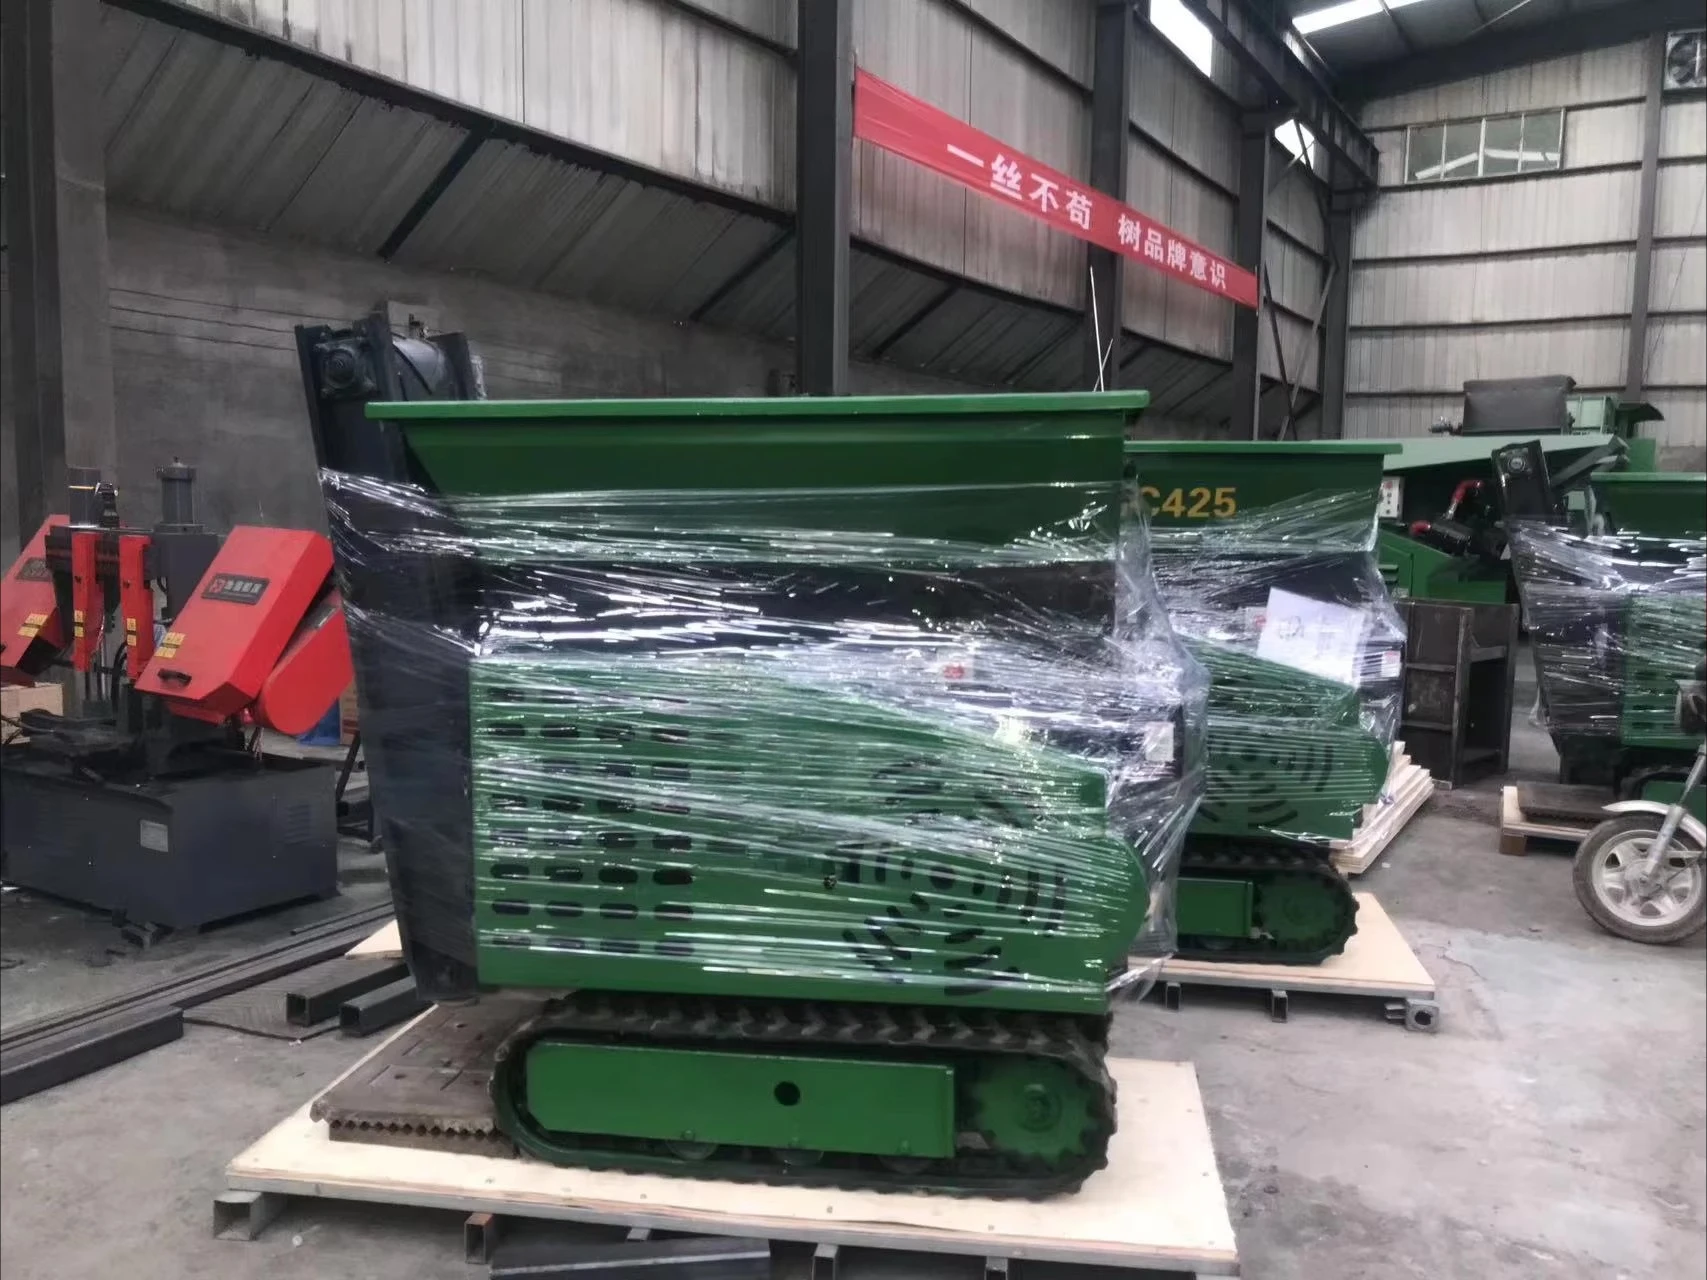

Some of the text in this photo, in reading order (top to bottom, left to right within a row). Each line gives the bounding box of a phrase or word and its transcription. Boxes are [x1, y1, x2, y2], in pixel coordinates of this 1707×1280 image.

[946, 143, 1226, 289] 一丝不苟 树品牌意识
[1120, 485, 1237, 518] C425
